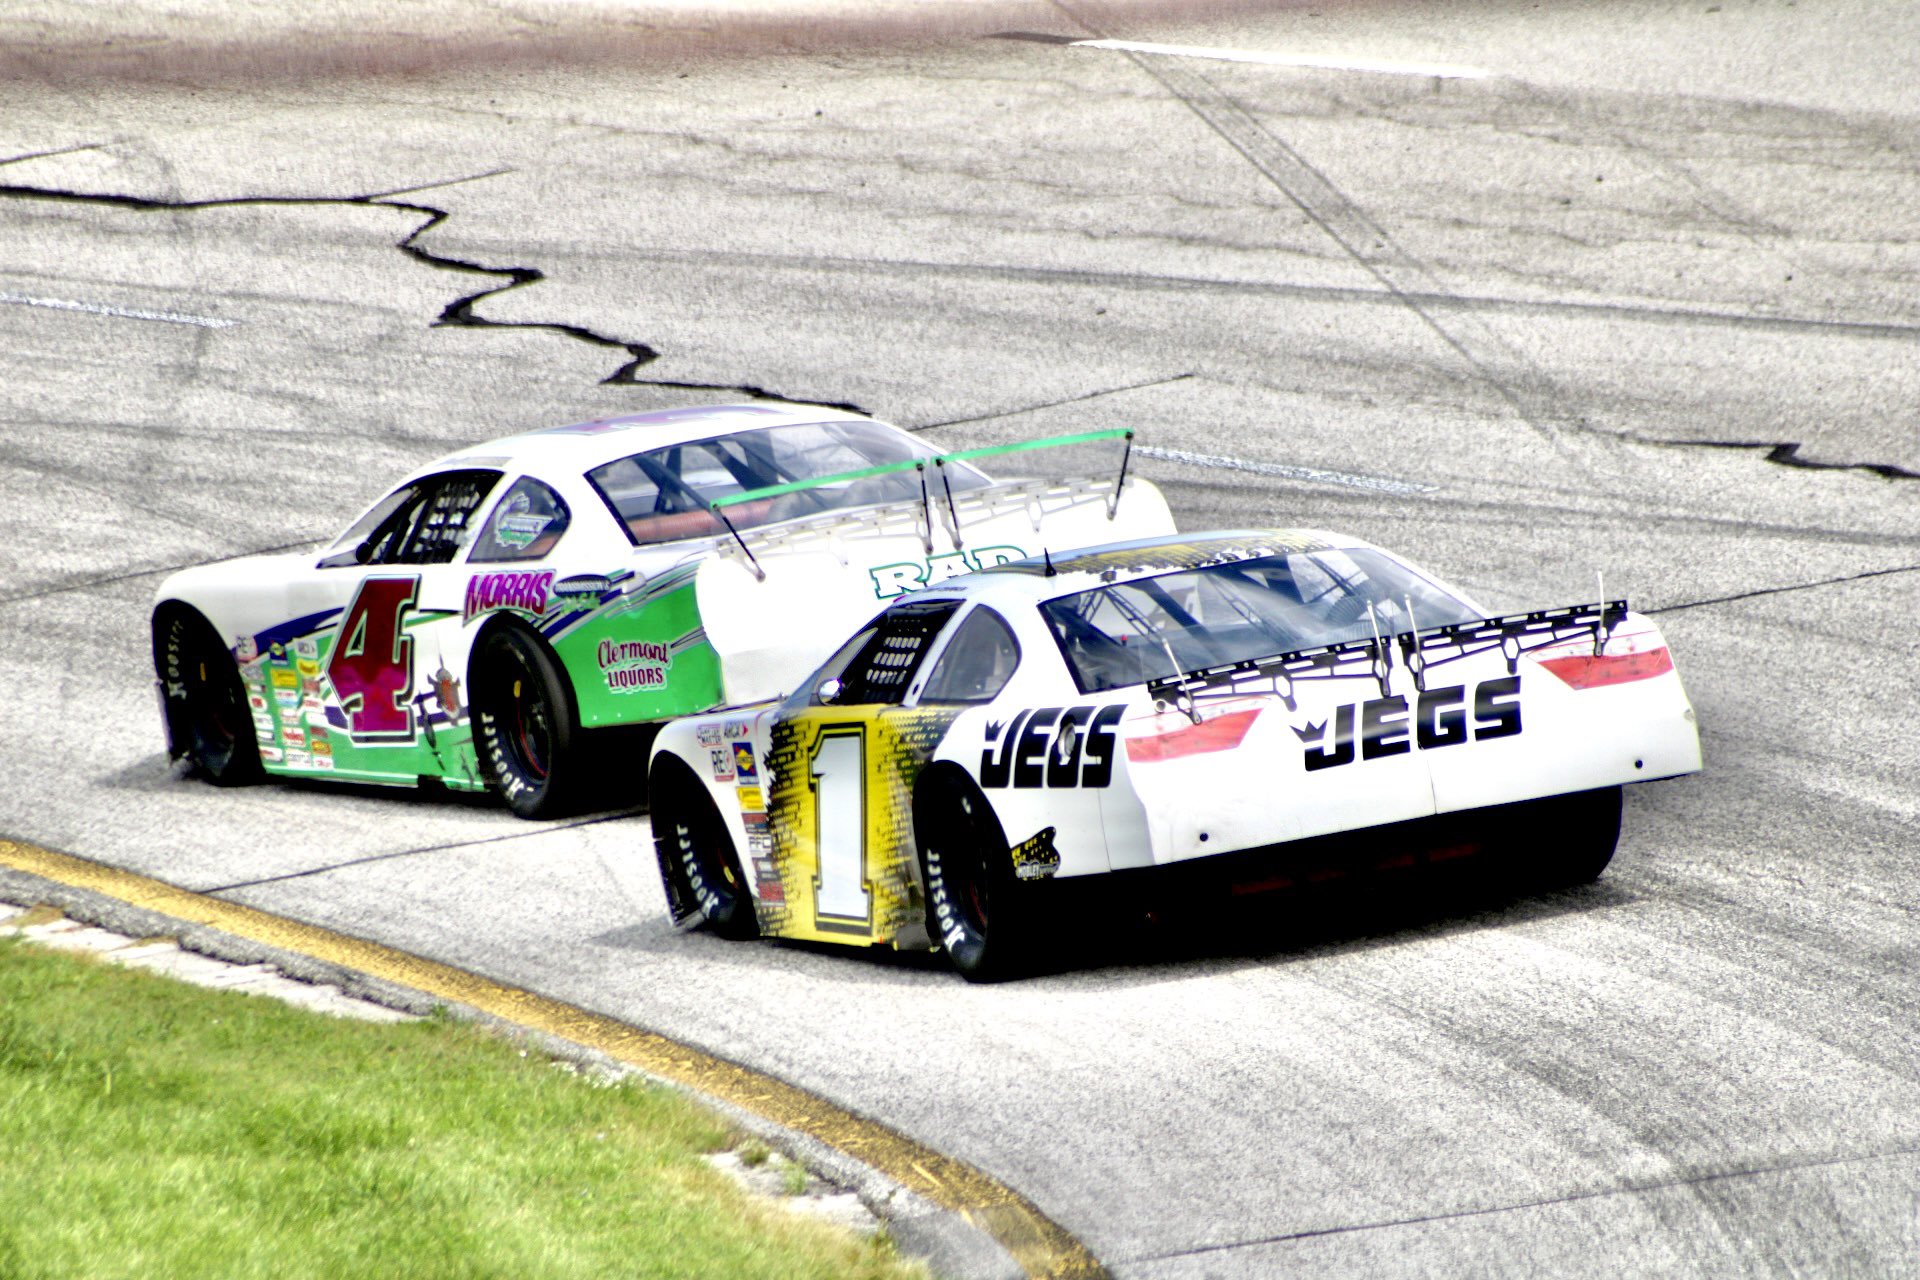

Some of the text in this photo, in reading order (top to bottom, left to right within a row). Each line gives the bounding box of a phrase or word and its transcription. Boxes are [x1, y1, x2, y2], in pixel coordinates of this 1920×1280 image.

[463, 570, 557, 628] MORRIS
[325, 573, 422, 744] 4
[598, 640, 669, 669] Clermont
[607, 667, 664, 689] LIQUORS
[980, 704, 1130, 788] JEGS
[1290, 676, 1523, 772] JEGS
[808, 721, 874, 937] 1
